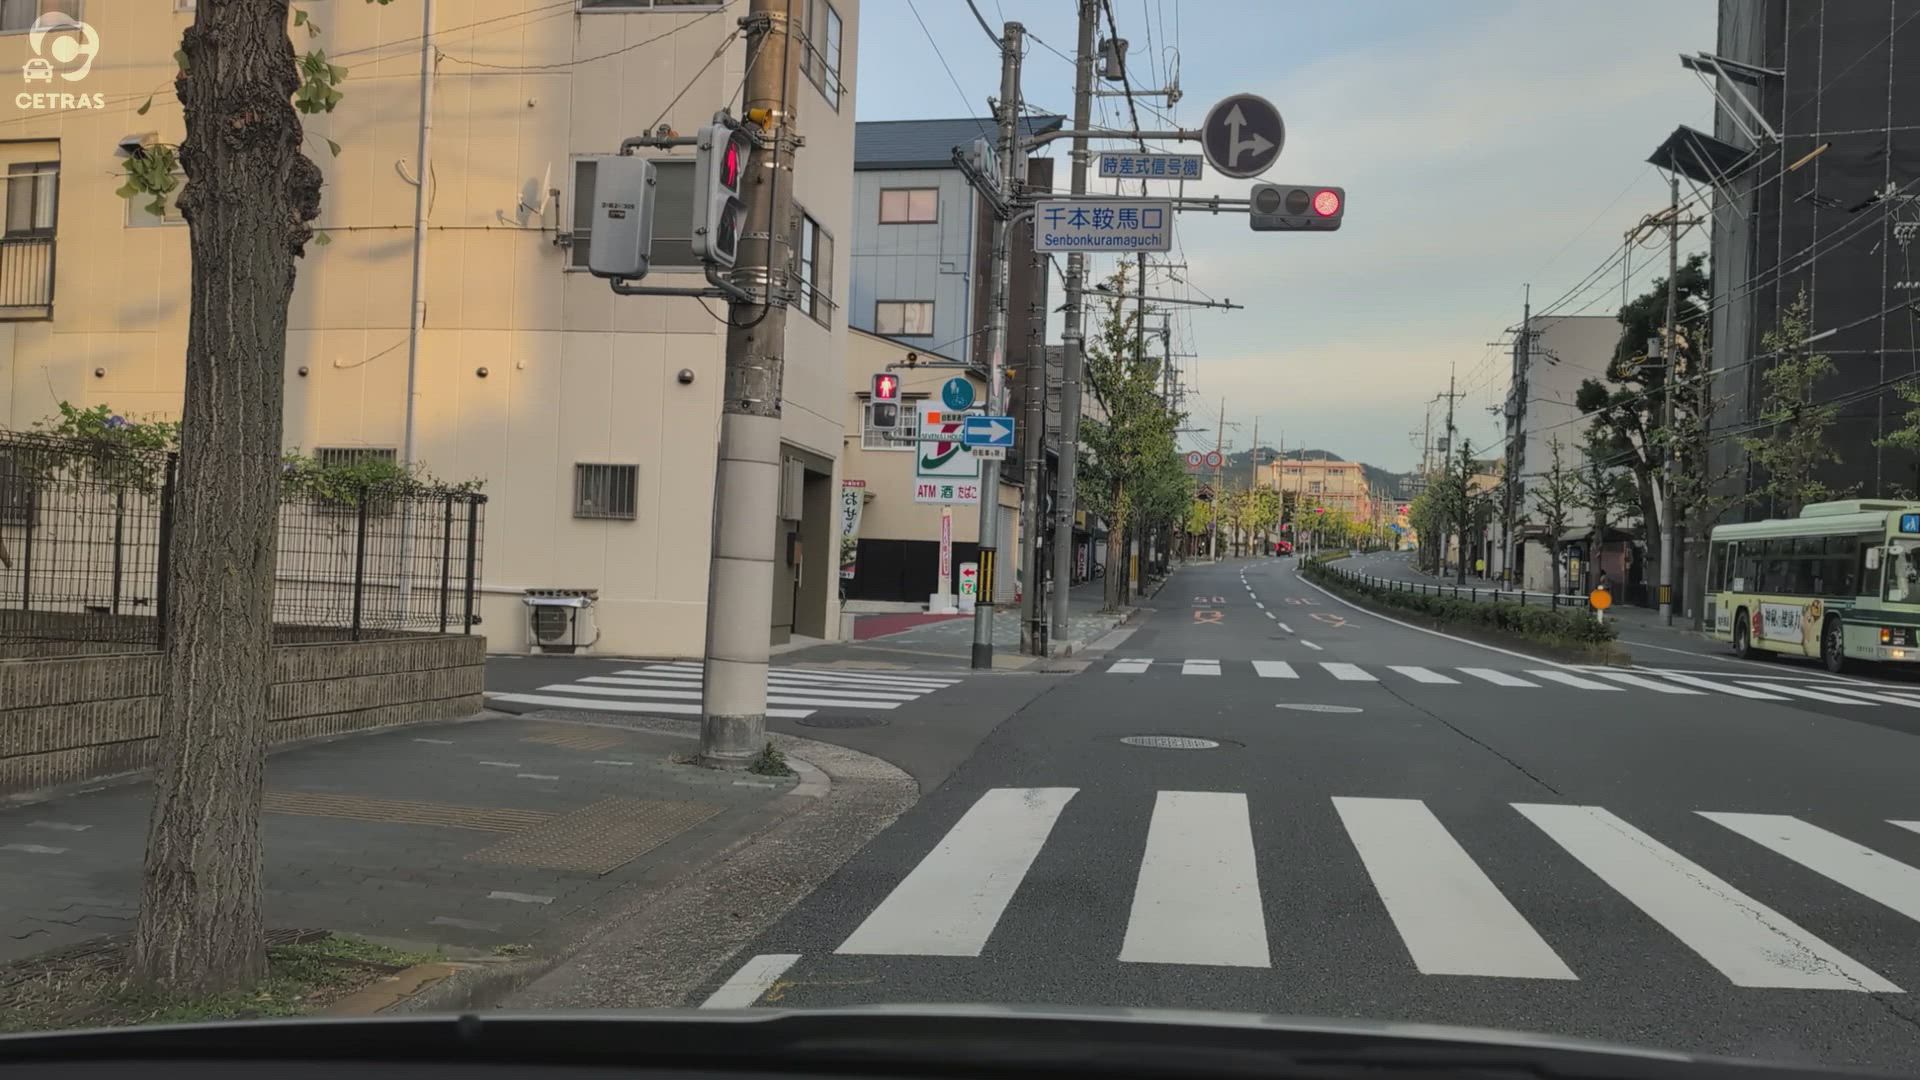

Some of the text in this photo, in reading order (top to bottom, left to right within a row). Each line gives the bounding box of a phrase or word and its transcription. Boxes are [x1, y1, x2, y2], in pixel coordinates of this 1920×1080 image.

[1102, 156, 1199, 176] 時差式信号機
[1043, 207, 1162, 230] 千本鞍馬口
[1044, 234, 1162, 248] Senbonkuramaguchi
[917, 484, 977, 498] ATM 酒 たばこ
